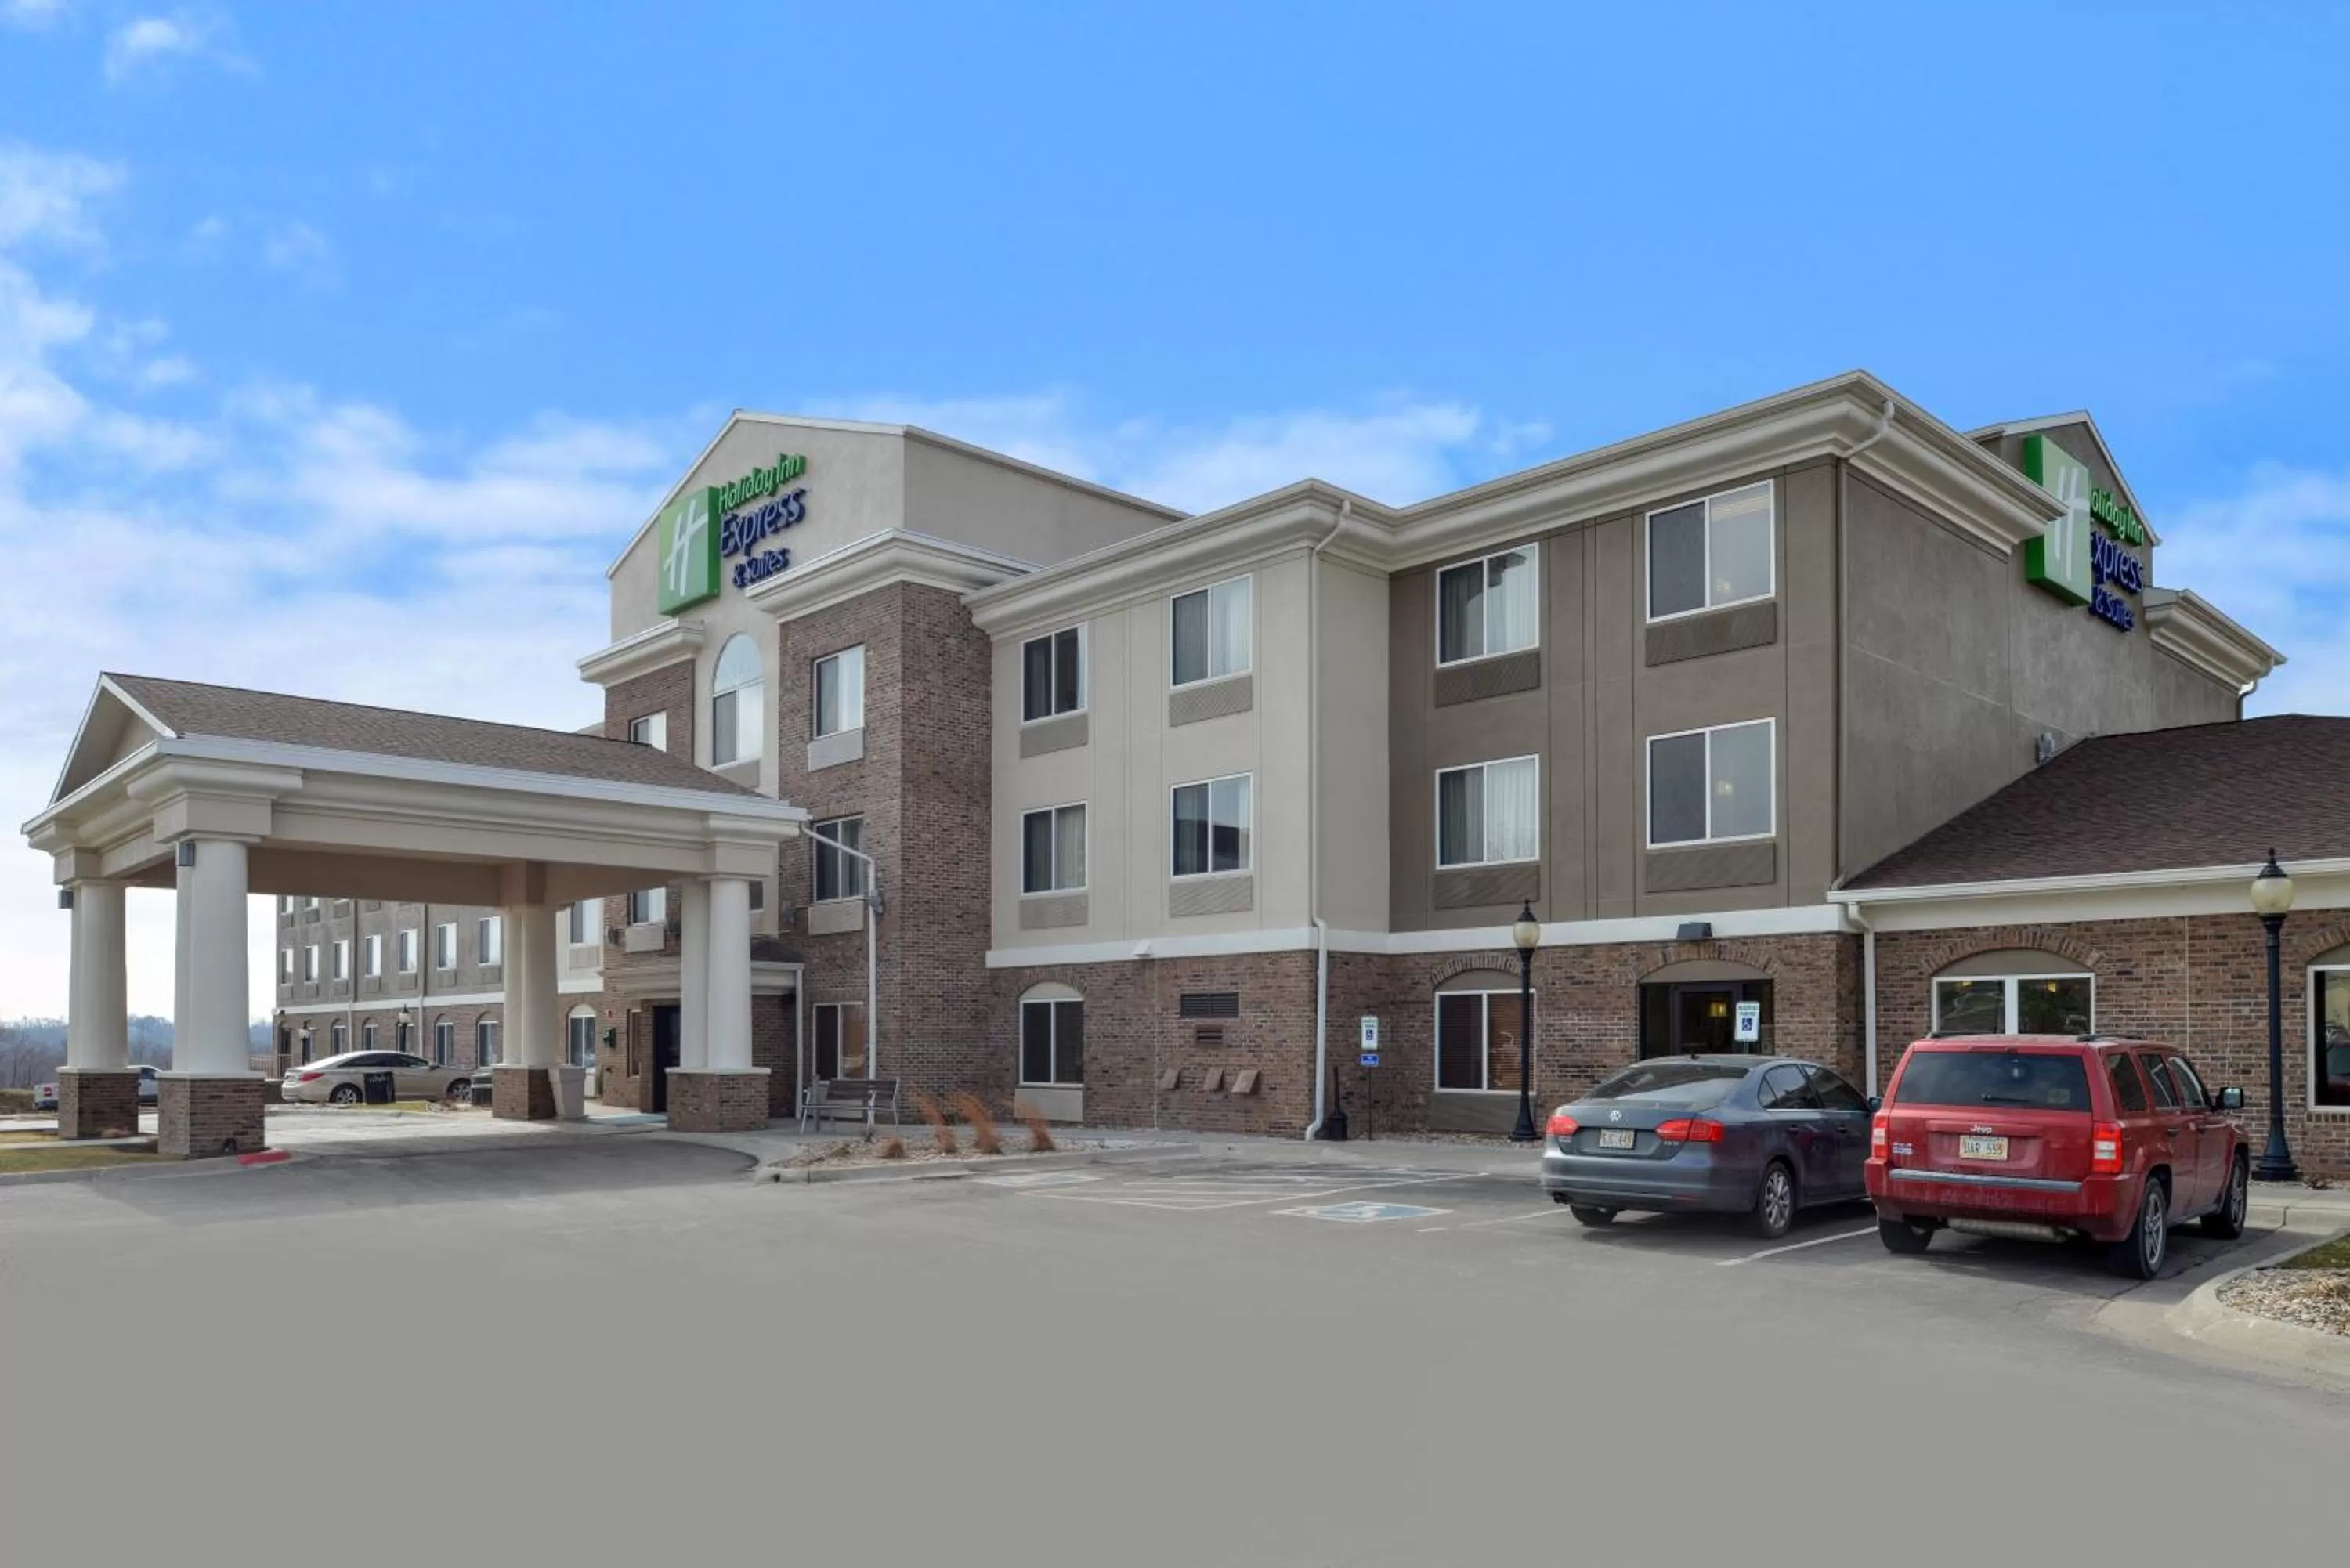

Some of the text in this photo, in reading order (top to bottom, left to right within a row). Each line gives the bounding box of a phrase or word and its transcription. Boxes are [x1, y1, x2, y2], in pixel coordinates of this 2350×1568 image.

[718, 453, 806, 514] Holiday Inn
[721, 489, 805, 558] Express
[2091, 488, 2127, 540] oliday
[745, 548, 790, 583] Suites
[2091, 532, 2144, 592] xpress
